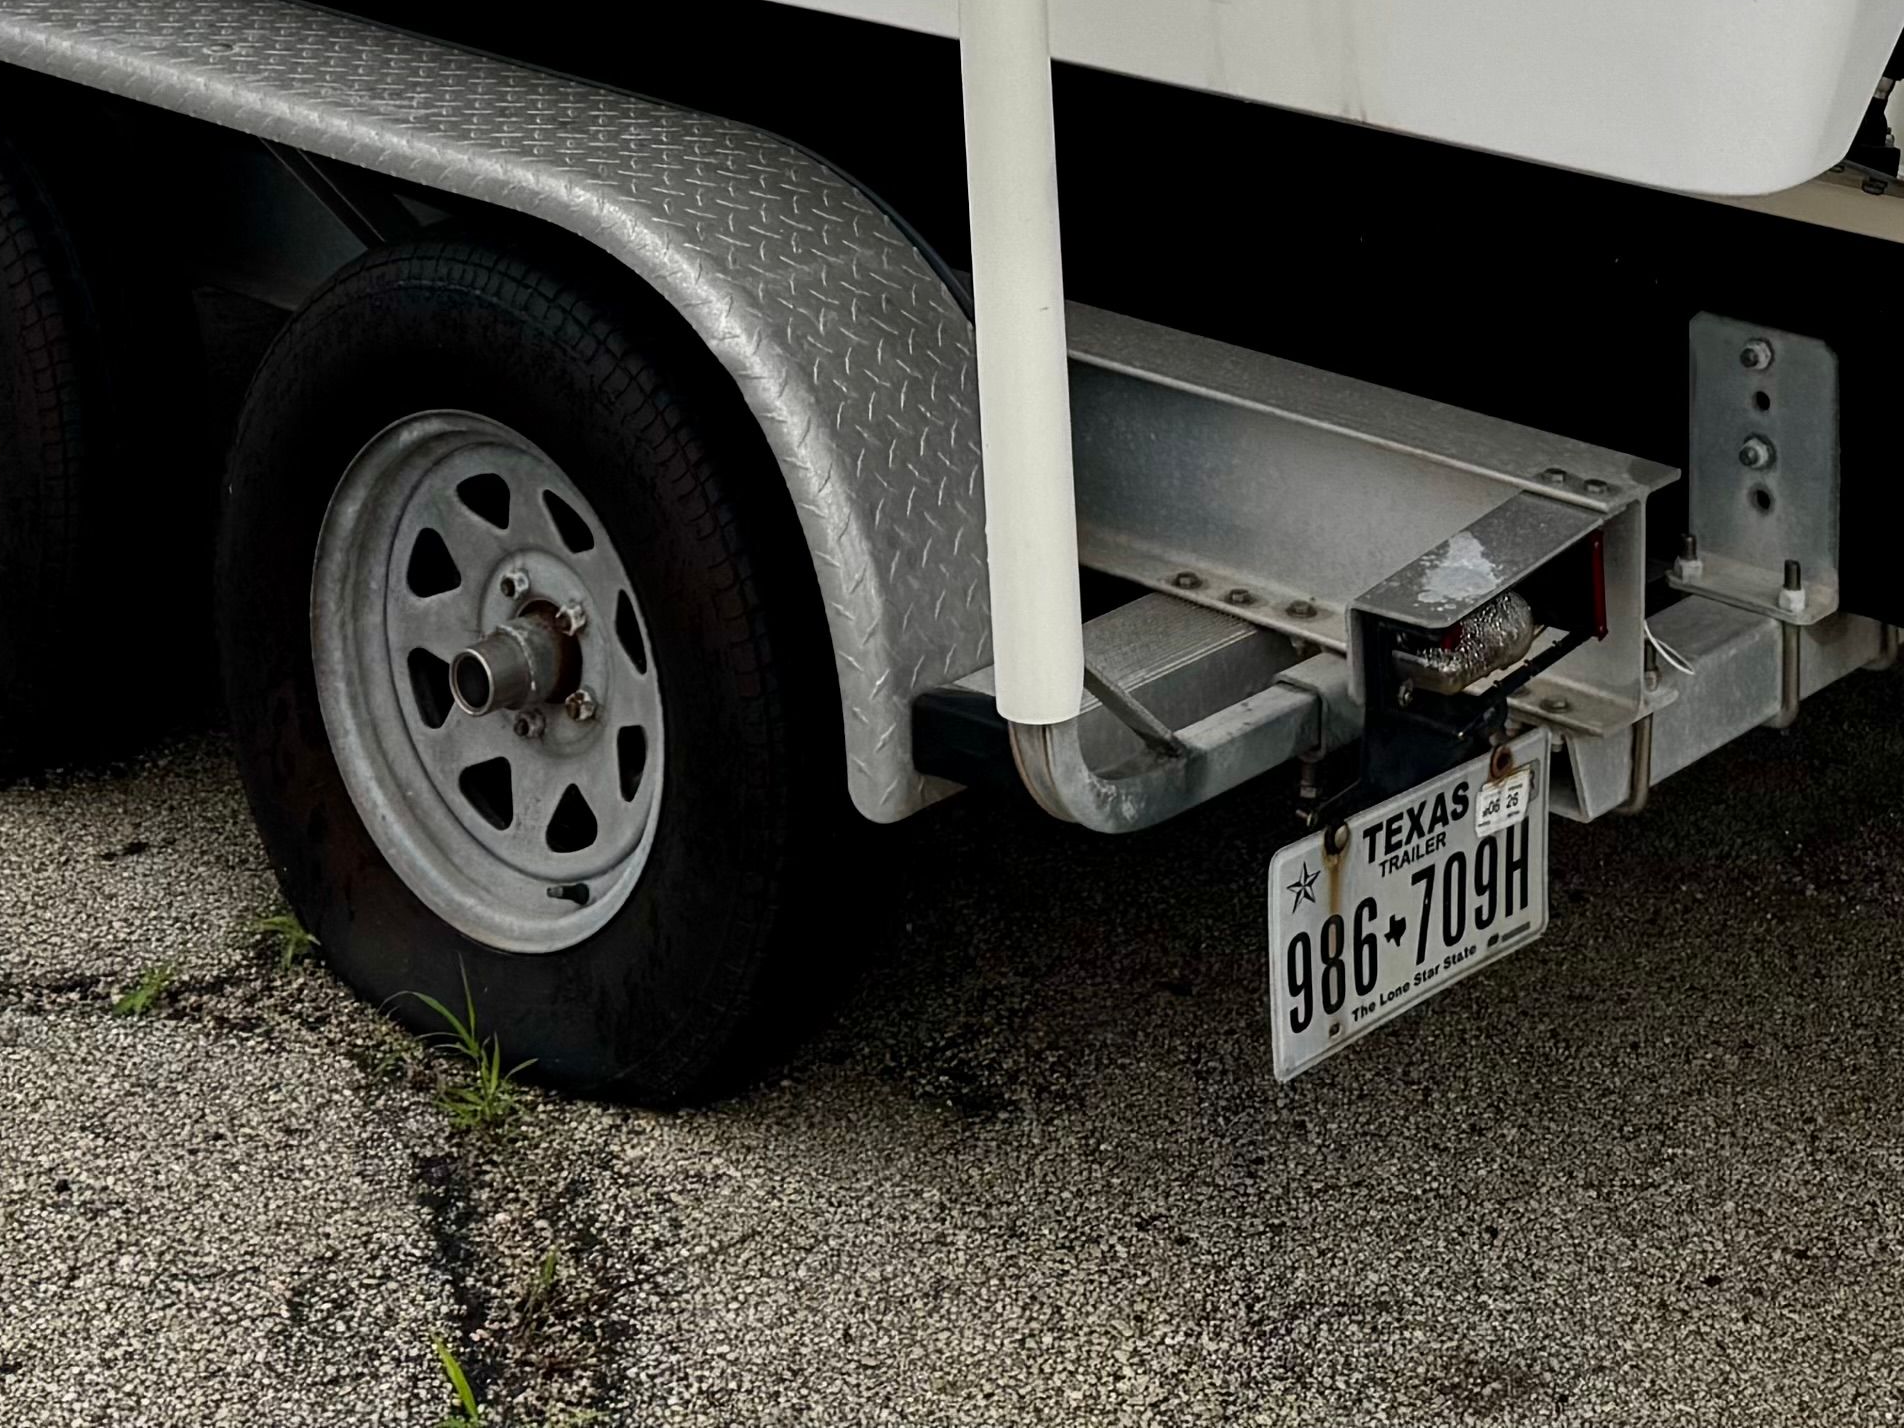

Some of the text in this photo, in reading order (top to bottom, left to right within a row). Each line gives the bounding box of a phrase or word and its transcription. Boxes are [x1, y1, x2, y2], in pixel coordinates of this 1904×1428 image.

[1363, 781, 1469, 864] TEXAS
[1379, 831, 1447, 878] TRAILER
[1287, 816, 1529, 1034] 986 709H
[1351, 945, 1477, 1022] The Lone Star State
